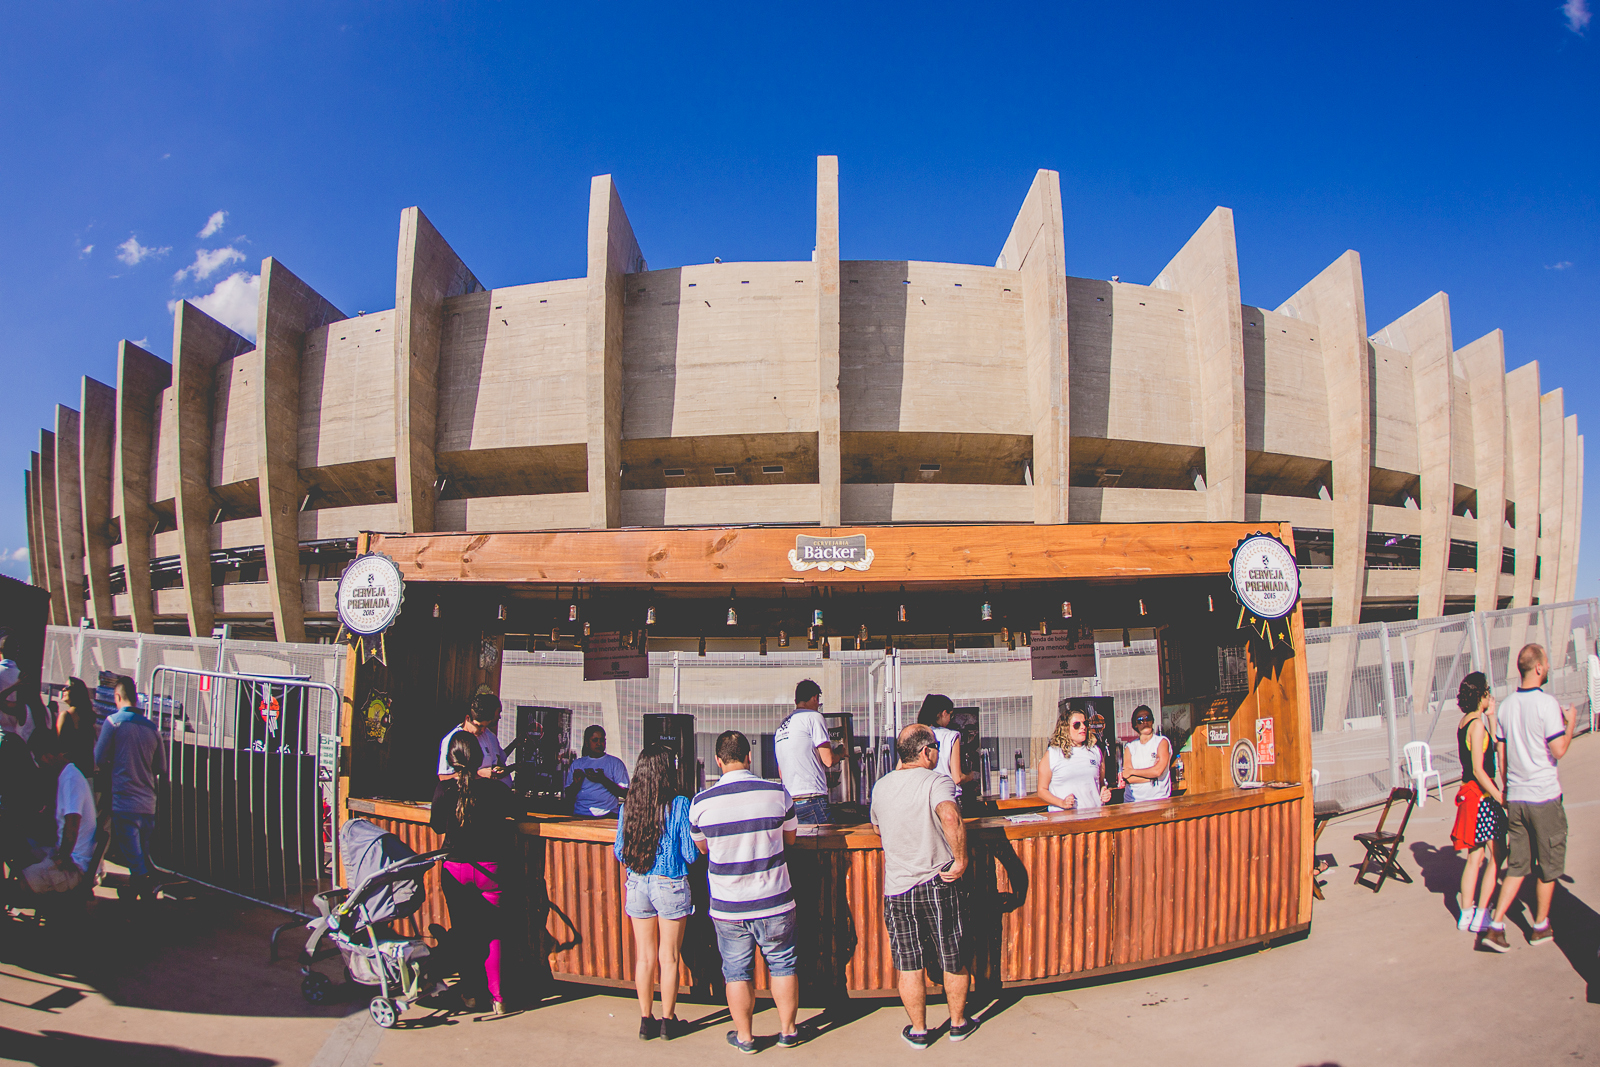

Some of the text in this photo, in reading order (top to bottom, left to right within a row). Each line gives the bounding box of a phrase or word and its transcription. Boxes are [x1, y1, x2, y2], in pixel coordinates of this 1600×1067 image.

[803, 545, 858, 559] Bäcker
[1248, 569, 1285, 580] CERVEJA
[1244, 580, 1290, 592] PREMIADA
[352, 586, 386, 598] CERVEJA
[1263, 592, 1277, 600] 2015
[346, 597, 390, 609] PREMIADA
[362, 609, 375, 617] 2015
[1030, 635, 1047, 643] Venda
[1031, 645, 1045, 653] para
